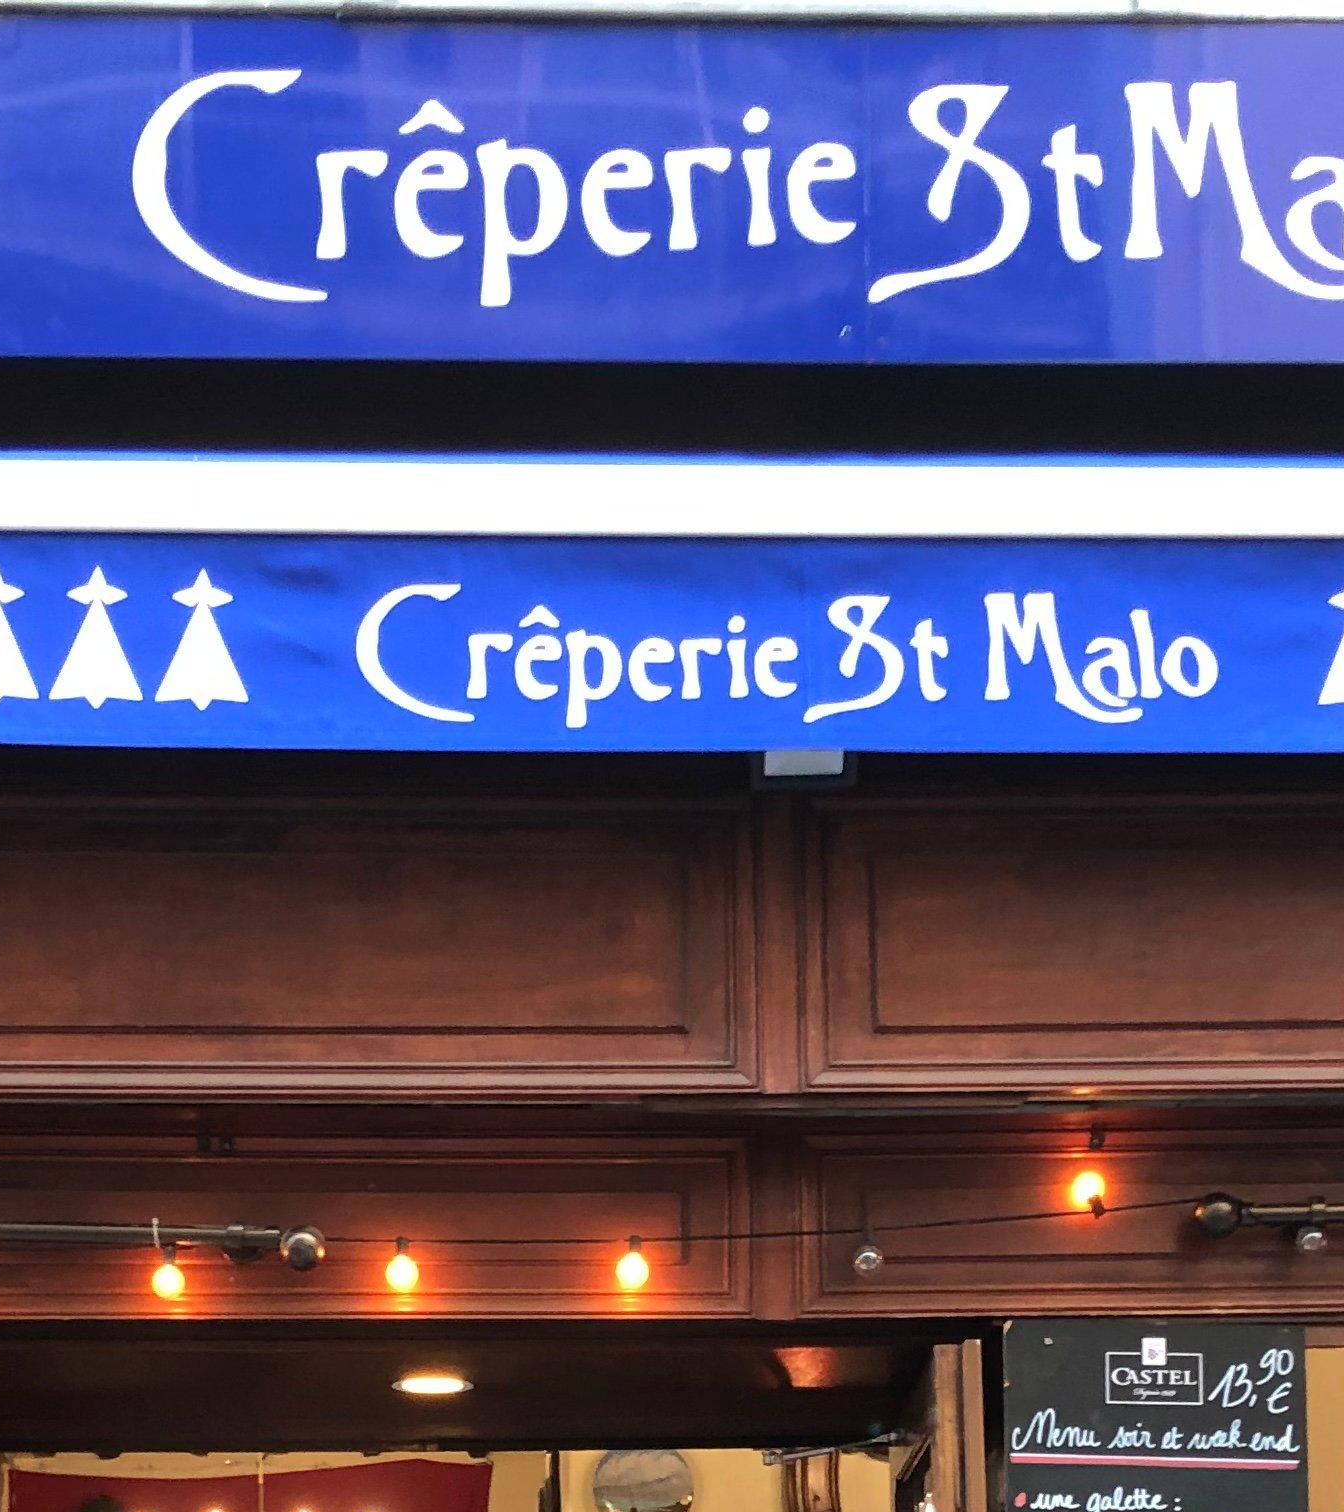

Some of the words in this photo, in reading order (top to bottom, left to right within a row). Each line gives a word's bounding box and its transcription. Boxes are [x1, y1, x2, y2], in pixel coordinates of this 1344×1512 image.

[133, 70, 855, 306] Crêperie
[869, 85, 1102, 302] St
[356, 585, 797, 727] Crêperie
[804, 596, 948, 722] St
[985, 593, 1217, 723] Malo
[1111, 1367, 1198, 1386] CASTEL
[1011, 1407, 1102, 1451] Menu
[1107, 1423, 1157, 1450] soir
[1160, 1426, 1185, 1450] et
[1250, 1423, 1300, 1452] end
[1030, 1492, 1080, 1510] une
